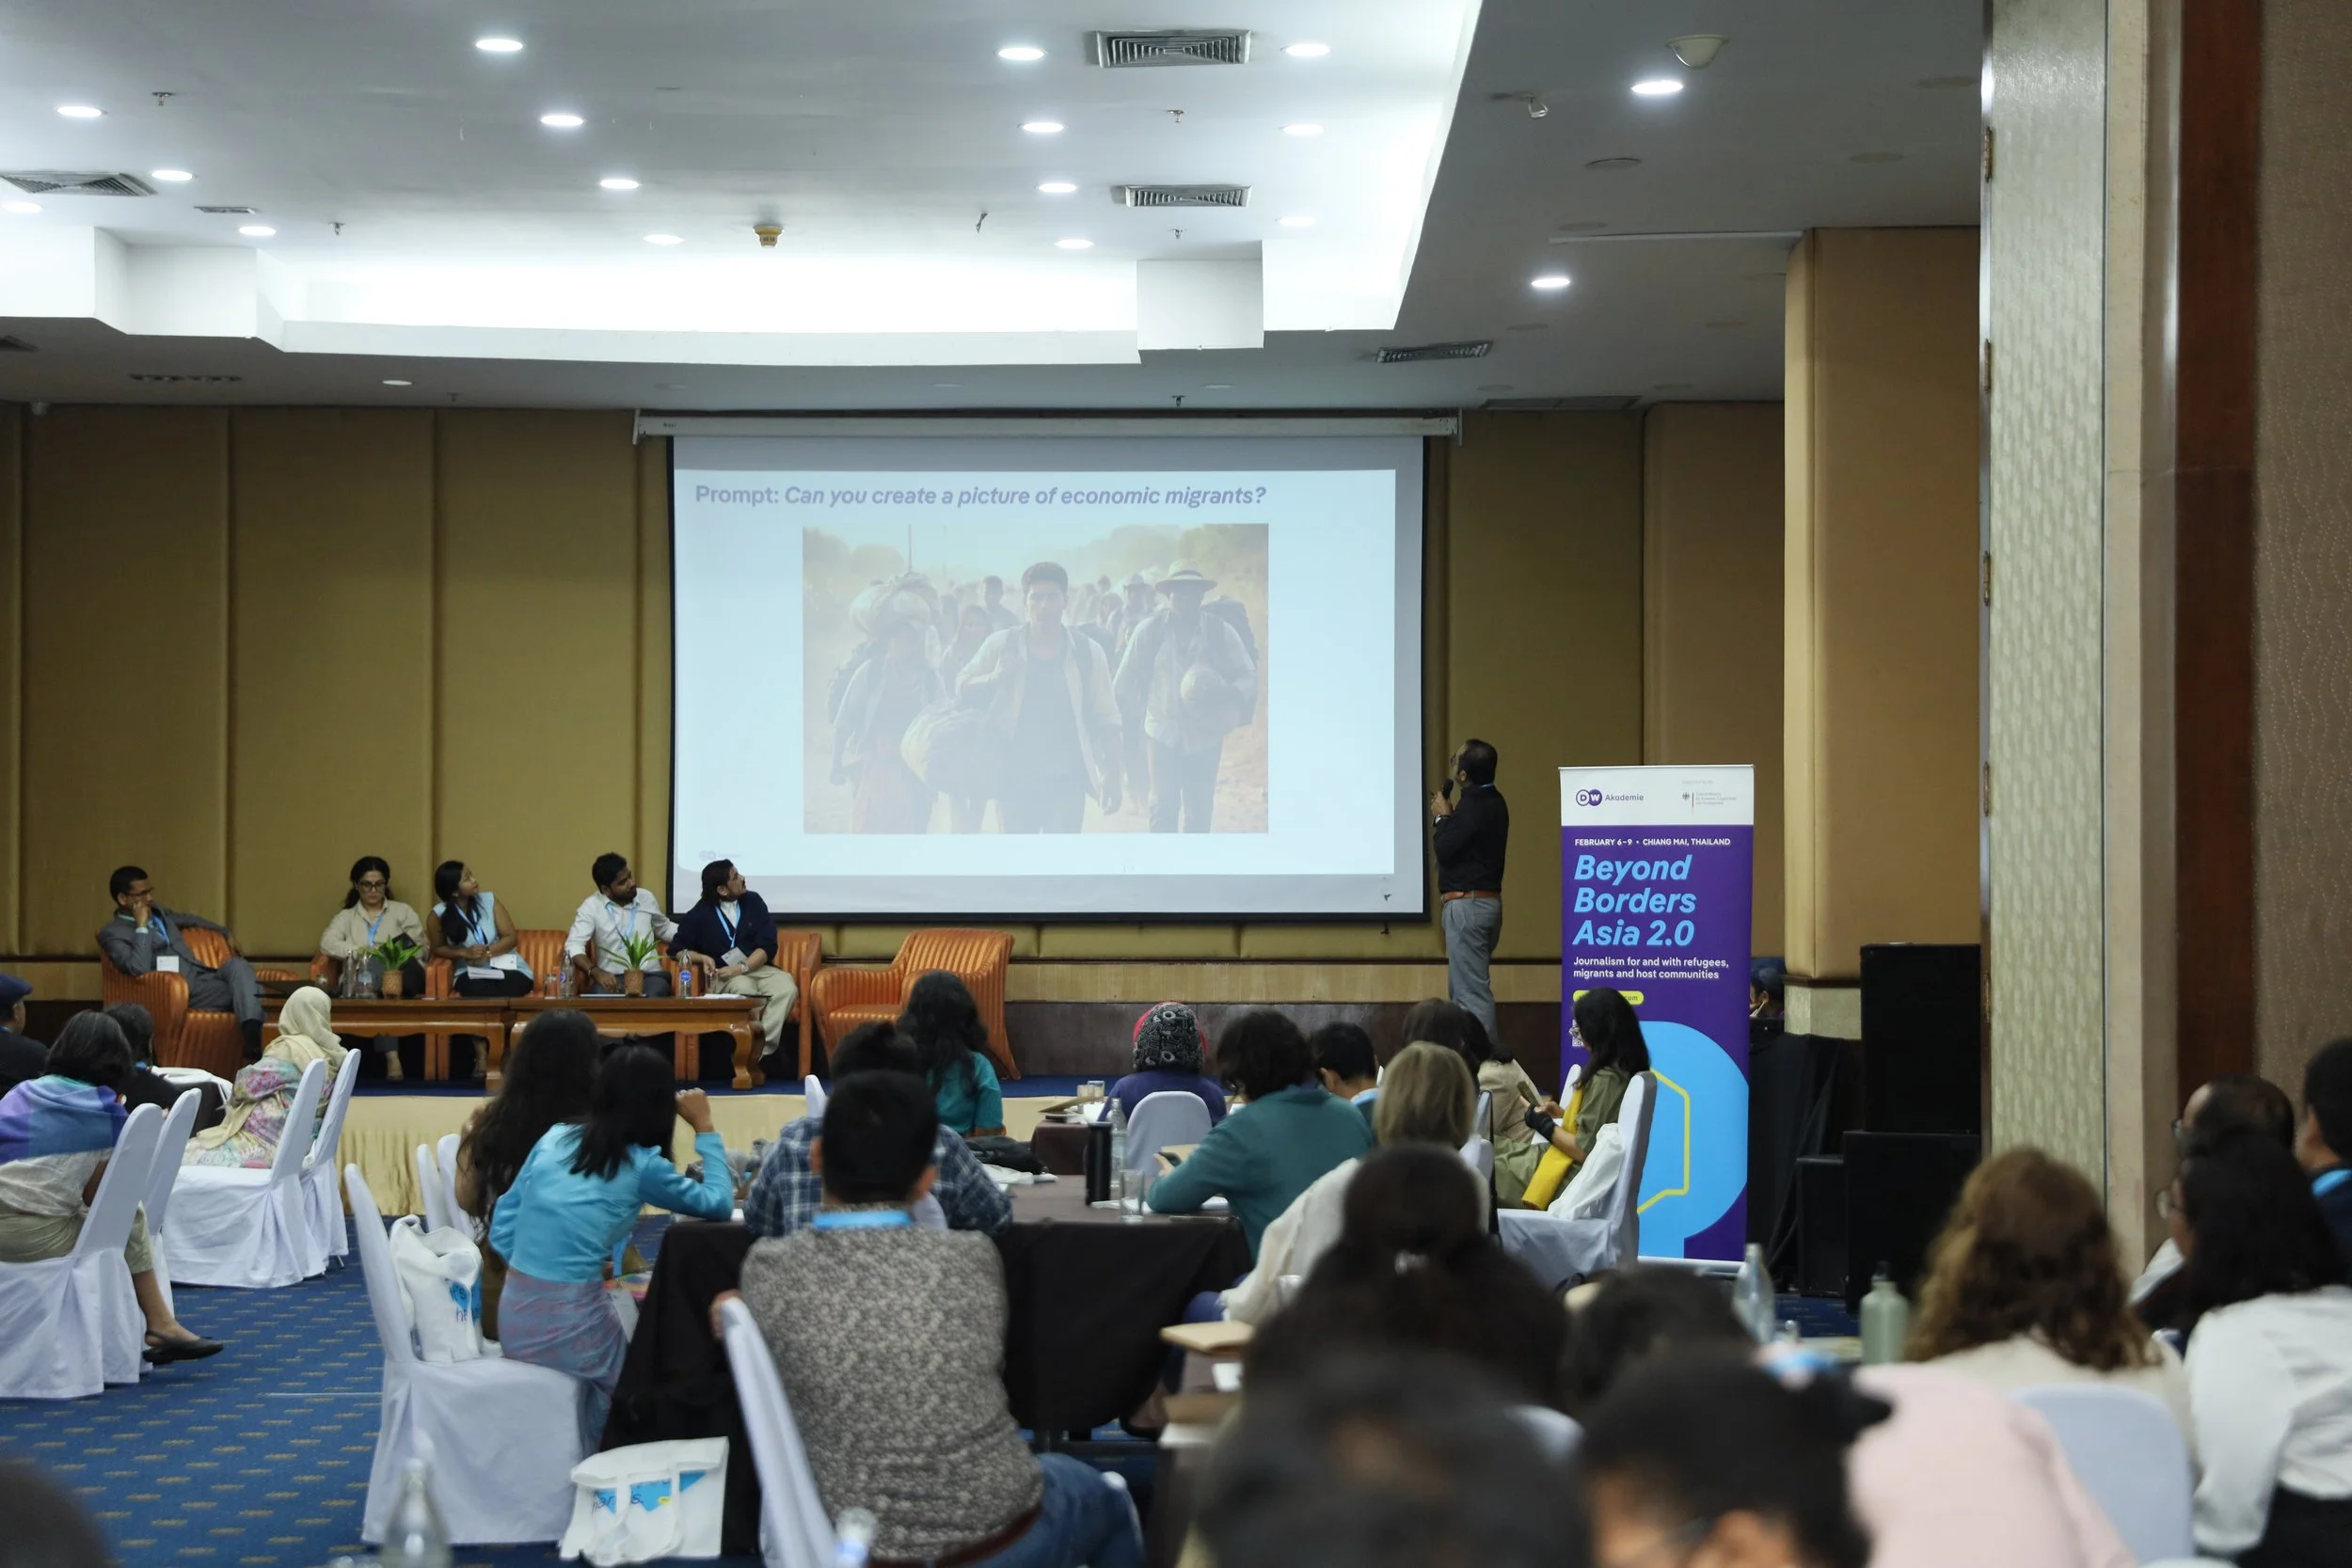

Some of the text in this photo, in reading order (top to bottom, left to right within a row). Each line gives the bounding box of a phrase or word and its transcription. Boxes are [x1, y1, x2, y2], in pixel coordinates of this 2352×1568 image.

[695, 484, 1267, 509] Prompt: Can you create a picture of economic migrants?
[1604, 793, 1645, 801] Akademie
[1574, 838, 1615, 847] FEBRUARY
[1642, 837, 1672, 846] CHIANG
[1673, 837, 1690, 847] MAI,
[1691, 837, 1731, 846] THAILAND
[1573, 854, 1692, 886] Beyond
[1573, 887, 1696, 913] Borders
[1572, 919, 1695, 946] Asia 2.0
[1573, 956, 1729, 969] Journalism for and with refugees,
[1573, 968, 1720, 979] migrants and host communities
